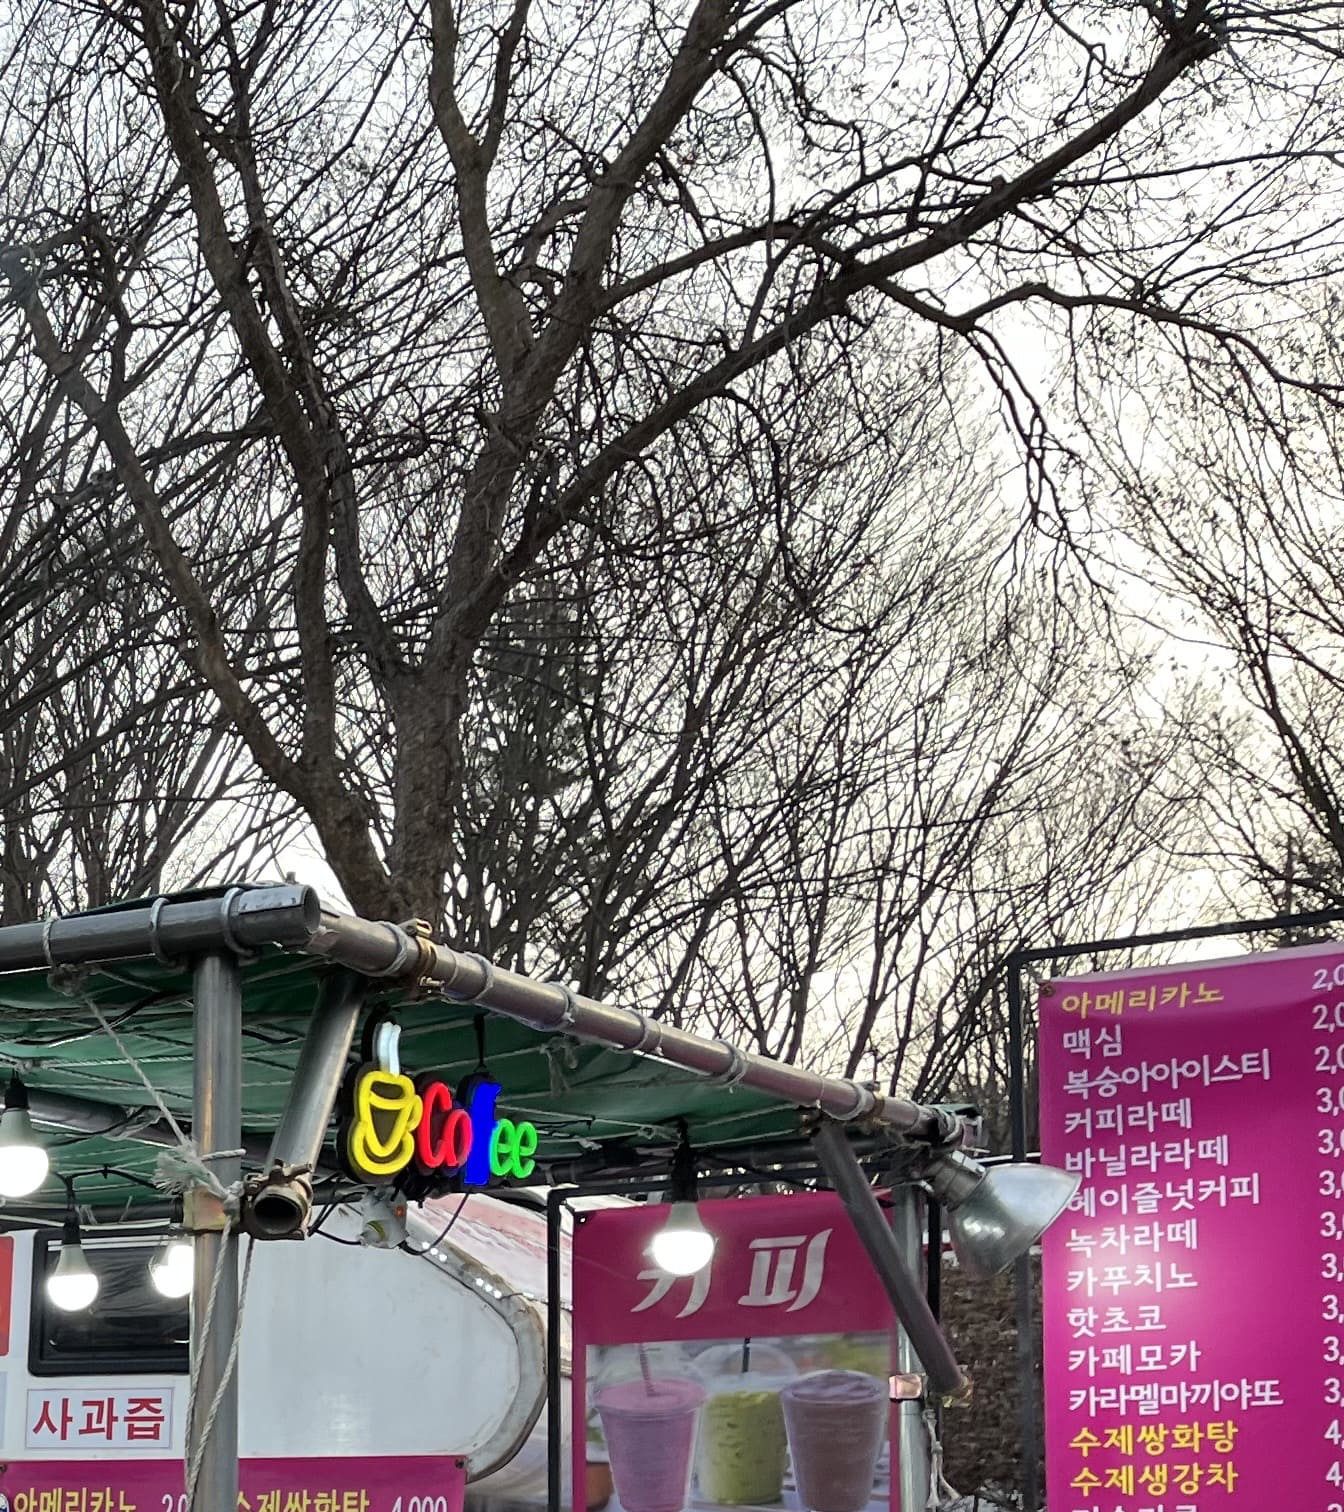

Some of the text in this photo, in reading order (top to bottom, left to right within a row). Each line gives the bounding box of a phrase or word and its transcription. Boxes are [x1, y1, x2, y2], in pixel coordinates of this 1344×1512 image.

[1061, 981, 1225, 1019] 아메리카노
[1062, 1023, 1122, 1060] 맥심
[1062, 1048, 1270, 1100] 복숭아아이스티
[1064, 1097, 1192, 1139] 커피라떼
[1064, 1134, 1230, 1180] 바닐라라떼
[1066, 1172, 1261, 1219] 헤이즐넛커피
[1065, 1218, 1199, 1258] 녹차라떼
[1065, 1262, 1199, 1297] 카푸치노
[1066, 1304, 1167, 1338] 핫초코
[1068, 1340, 1202, 1377] 카페모카
[1069, 1378, 1284, 1417] 카라멜마끼야또
[32, 1397, 165, 1441] 사과즙
[1069, 1420, 1239, 1458] 수제쌍화탕
[1070, 1461, 1239, 1497] 수제생강차
